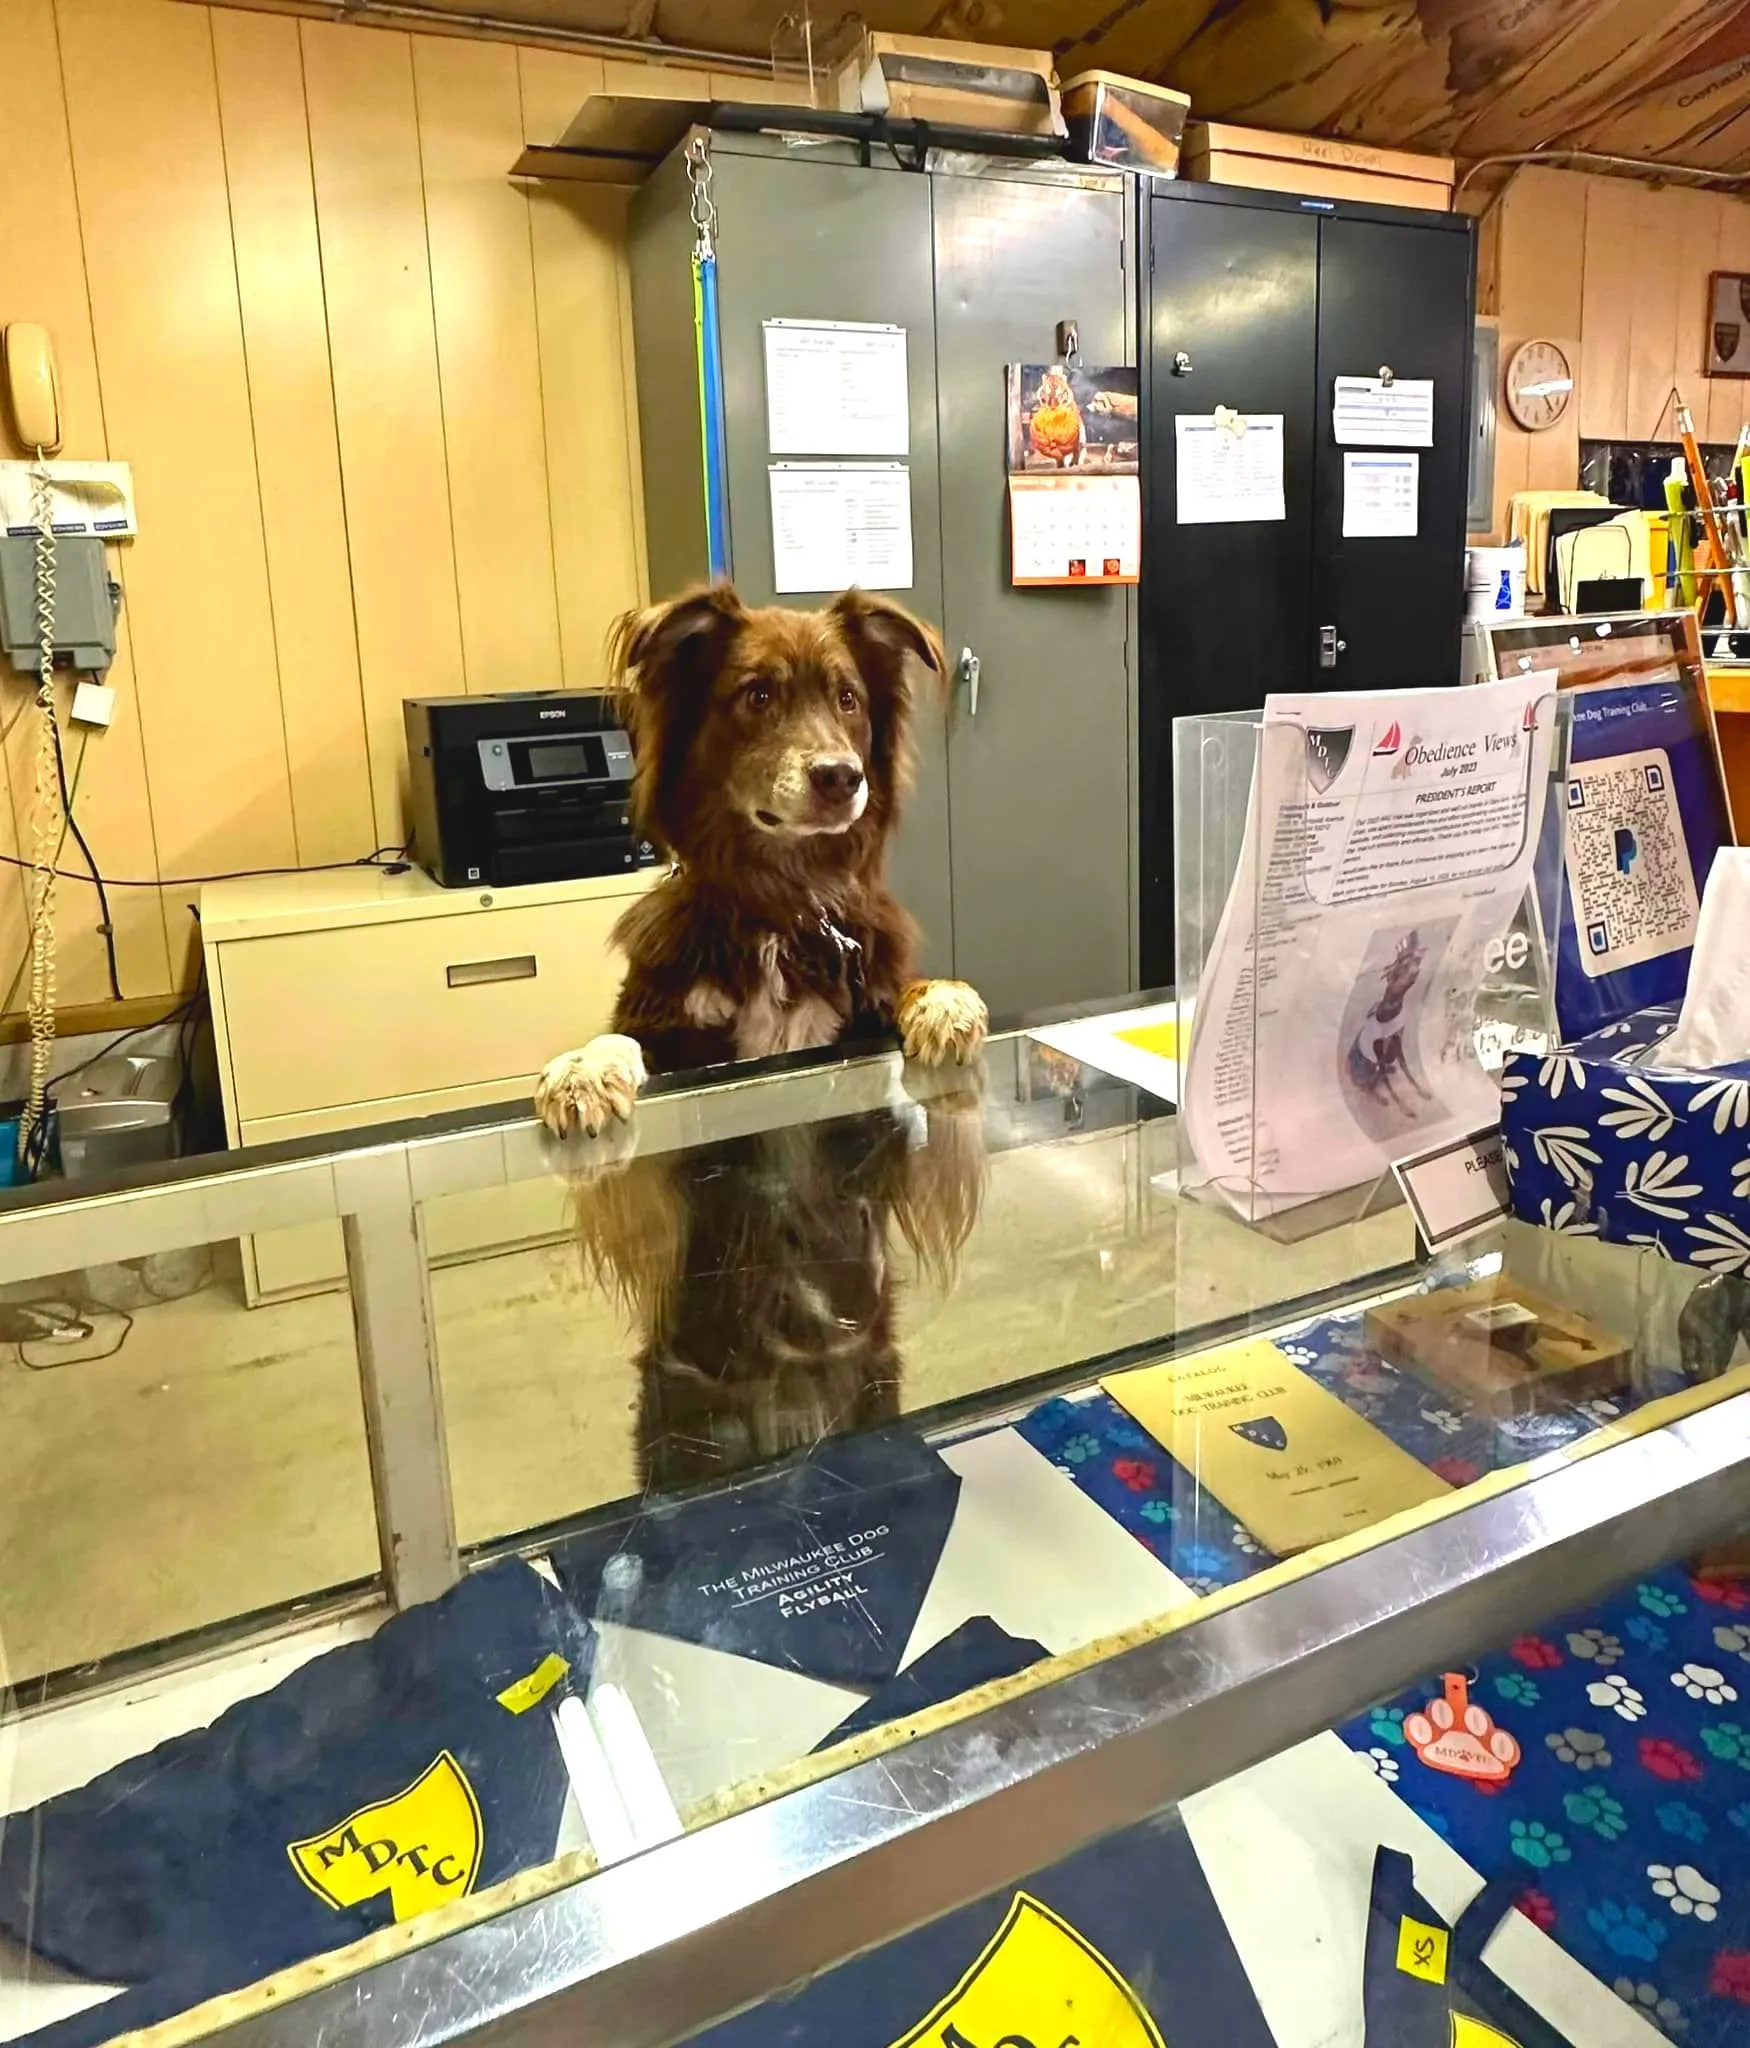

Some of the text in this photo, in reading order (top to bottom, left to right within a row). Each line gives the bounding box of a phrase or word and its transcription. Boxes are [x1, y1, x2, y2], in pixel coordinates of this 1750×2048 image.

[540, 710, 566, 719] EPSON
[1587, 709, 1602, 721] Dog
[1602, 705, 1631, 717] Training
[1405, 733, 1517, 766] Obedience Views
[1440, 762, 1478, 778] July 2023
[1415, 781, 1497, 804] PRESIDENT'S REPORT
[698, 1525, 890, 1597] THE MILWAUKEE DOG
[732, 1546, 874, 1600] TRAINING CLUB
[778, 1572, 854, 1606] AGILITY
[780, 1584, 869, 1619] FLYBALL
[316, 1826, 465, 1886] MDTC
[1413, 1937, 1435, 1966] XS
